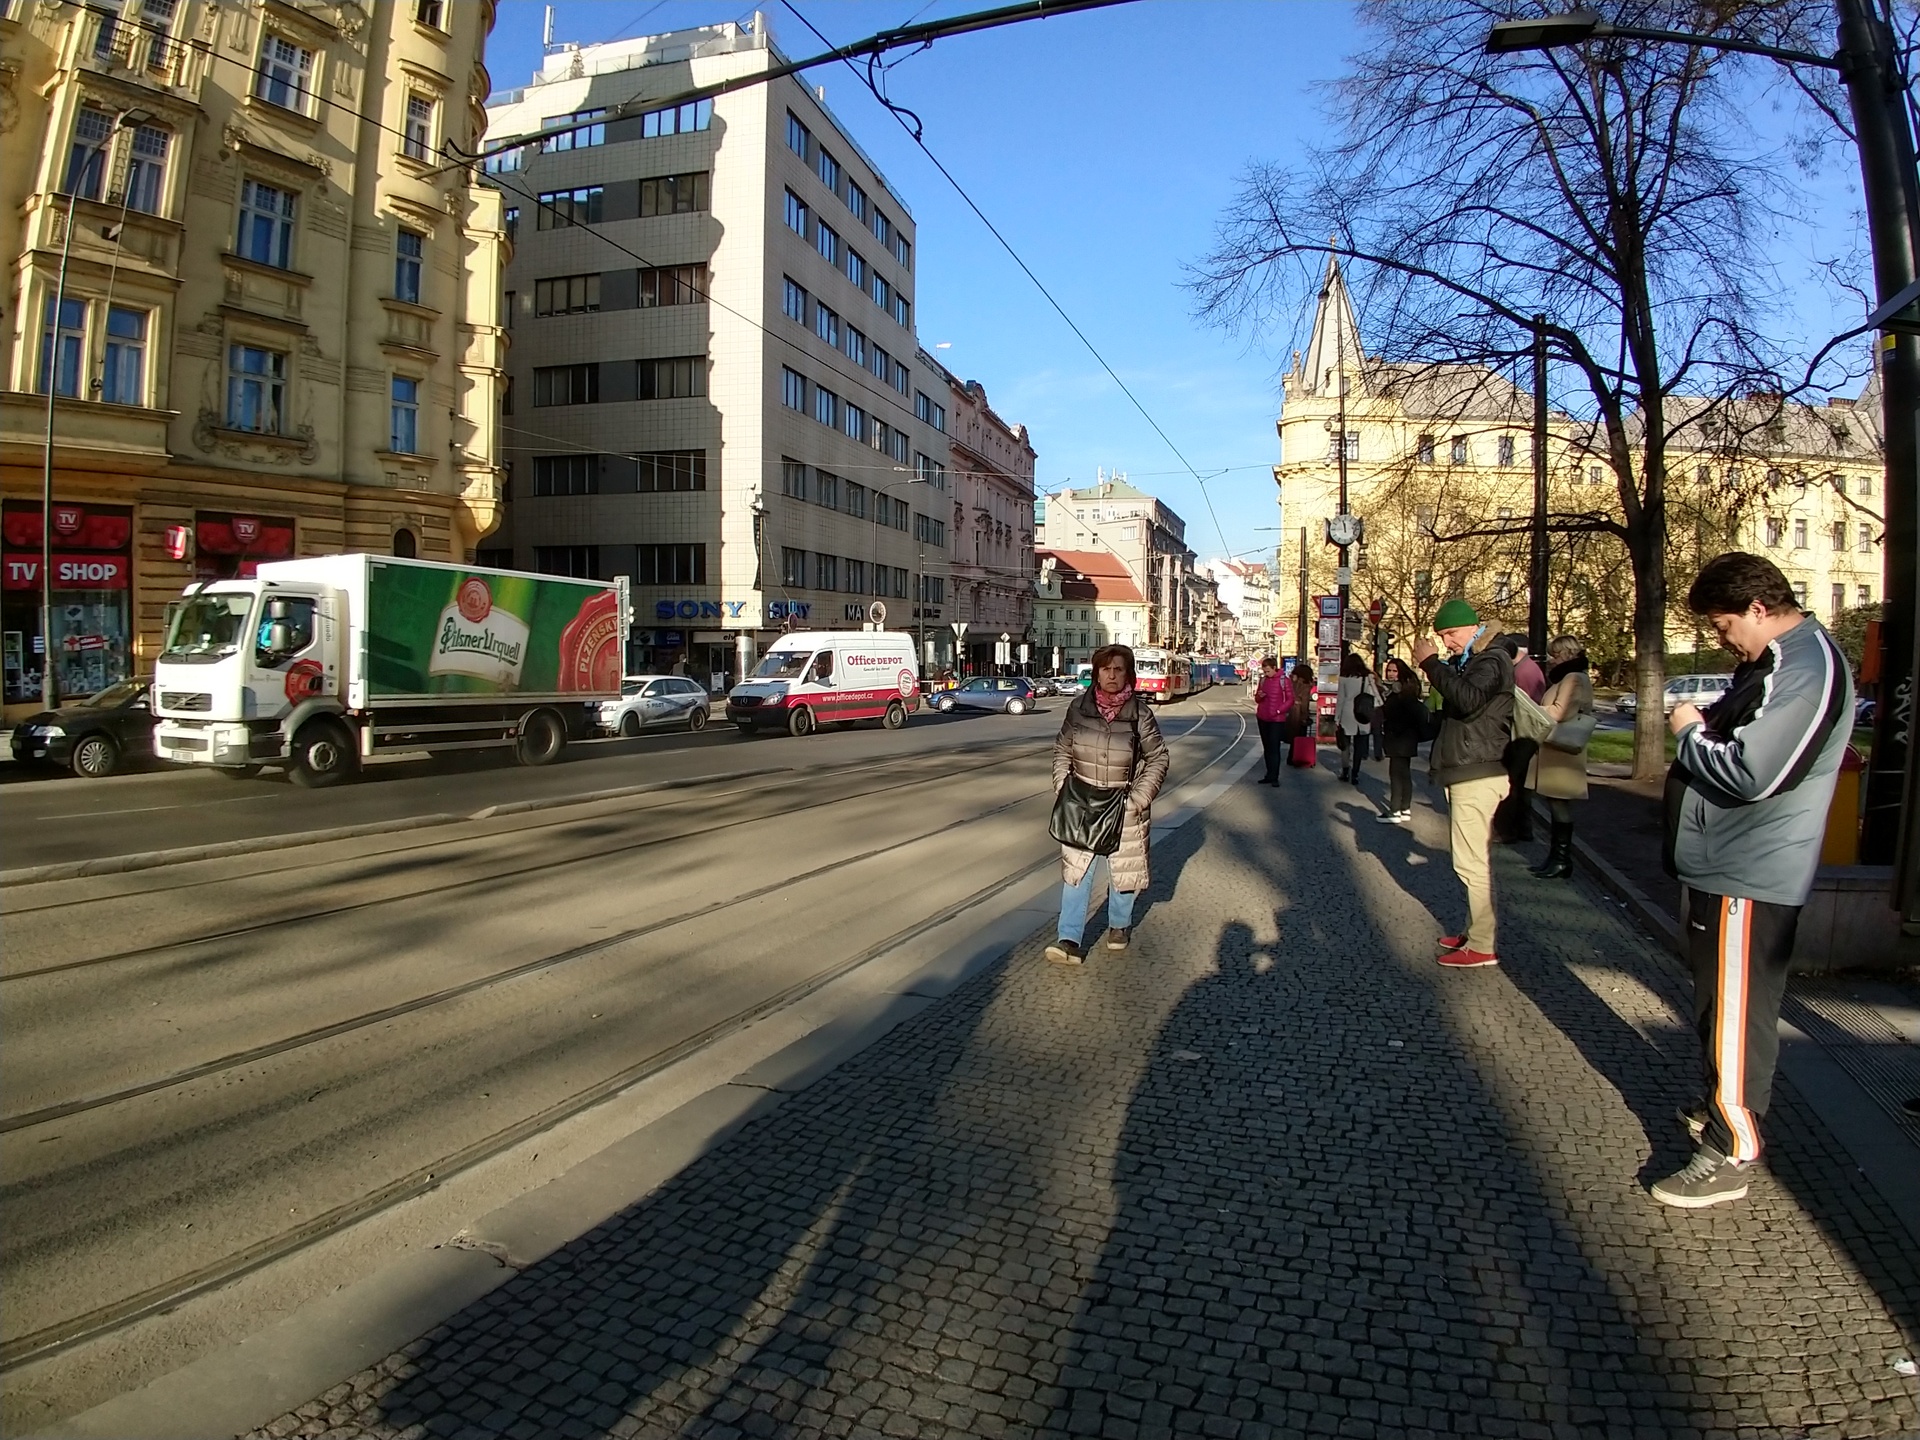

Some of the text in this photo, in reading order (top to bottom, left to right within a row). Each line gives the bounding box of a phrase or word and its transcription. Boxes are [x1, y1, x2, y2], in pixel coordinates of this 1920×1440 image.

[59, 513, 77, 524] TV
[238, 524, 254, 533] TV
[168, 529, 185, 549] TV
[8, 562, 118, 581] TV SHOP
[655, 600, 747, 619] SONY
[439, 616, 521, 662] Pilsner Urquell
[847, 655, 903, 665] Office DEPOT
